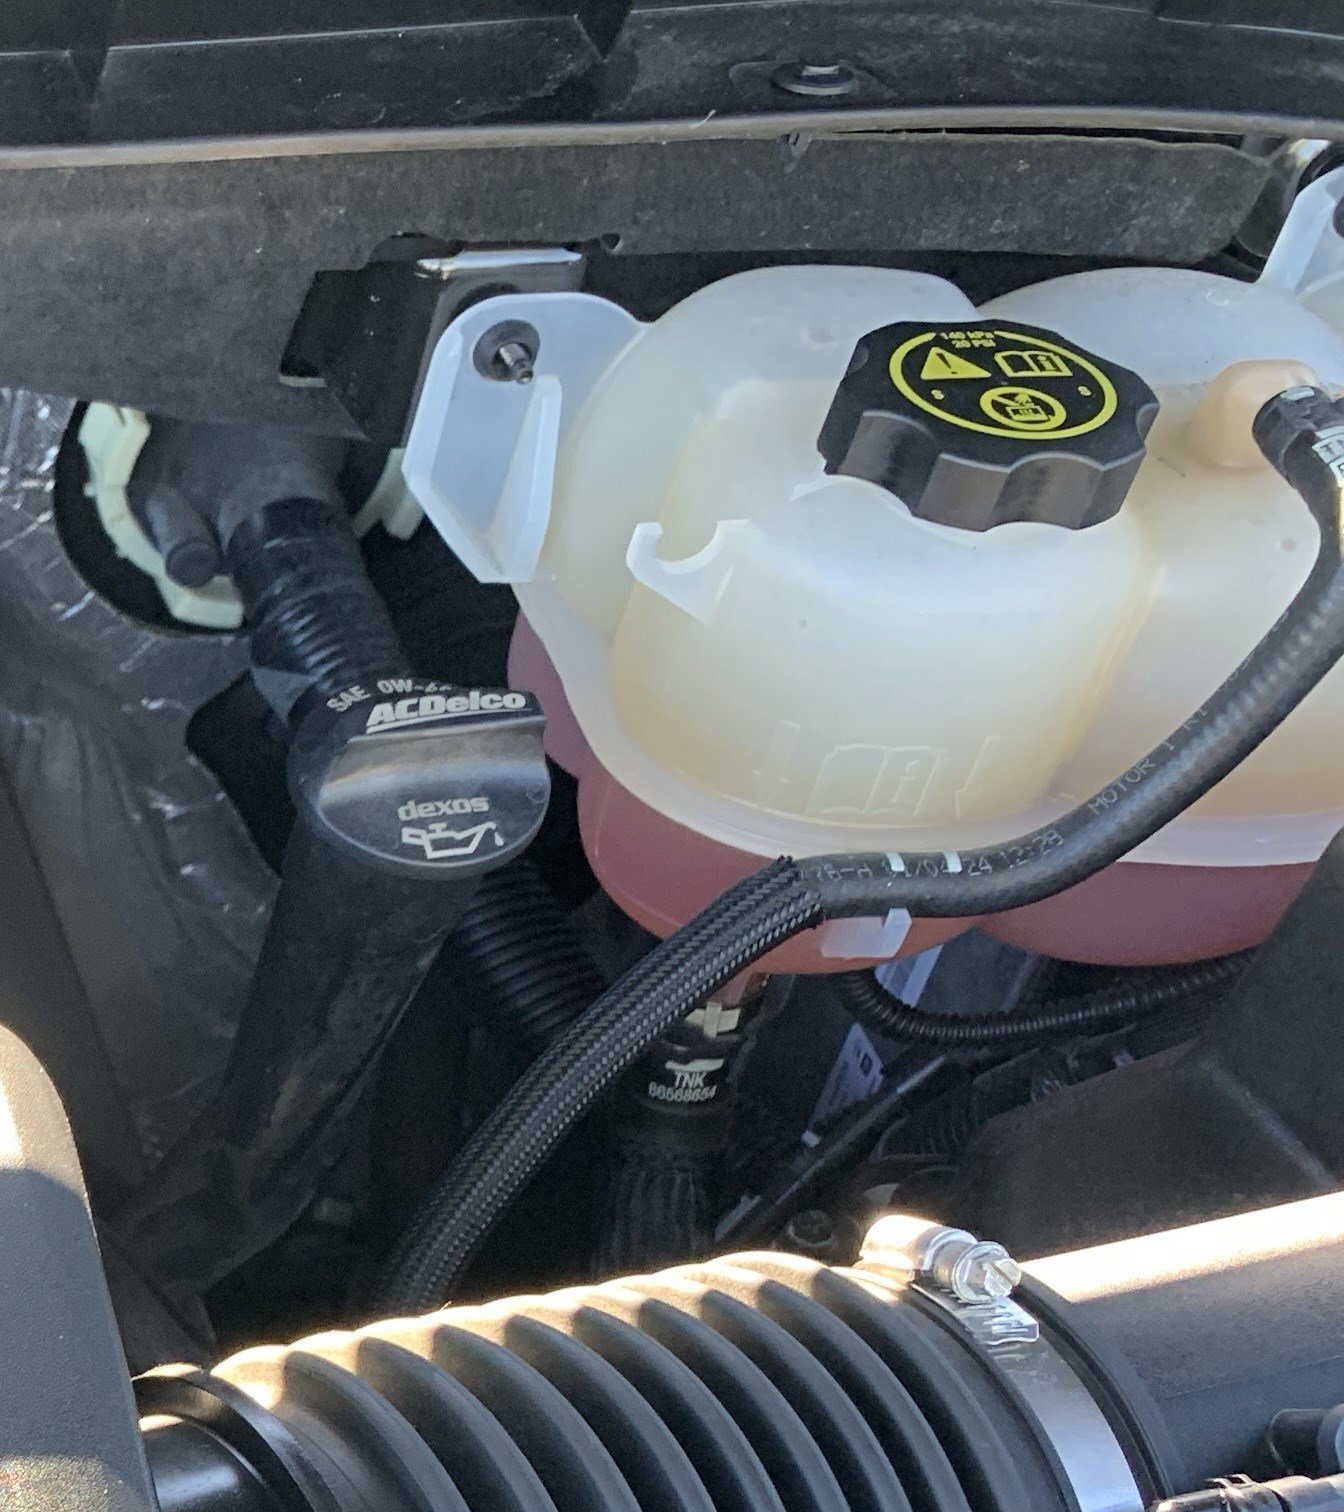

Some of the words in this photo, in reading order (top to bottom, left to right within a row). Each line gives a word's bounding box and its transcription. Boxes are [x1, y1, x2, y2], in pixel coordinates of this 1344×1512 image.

[326, 685, 371, 713] SAE
[365, 690, 527, 728] ACDelco
[1087, 758, 1156, 816] MOTOR
[397, 797, 490, 821] dexos
